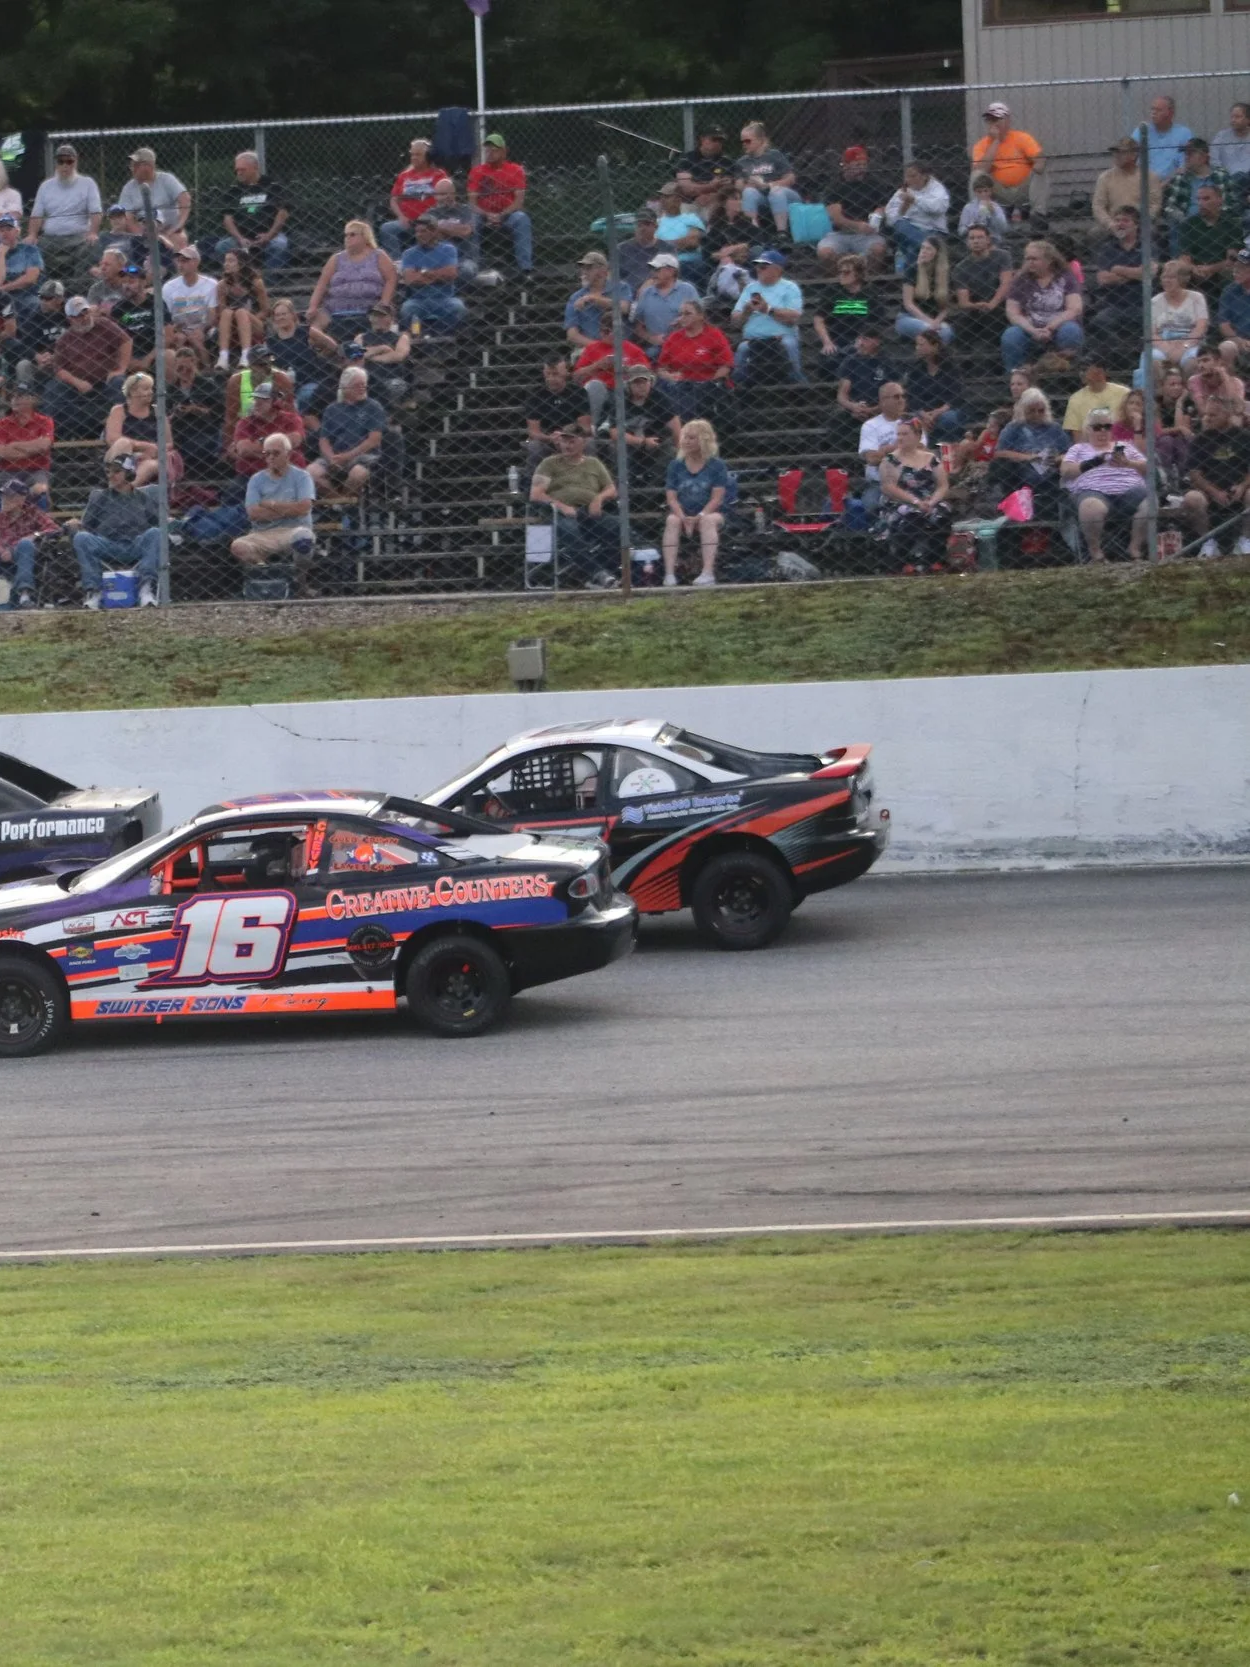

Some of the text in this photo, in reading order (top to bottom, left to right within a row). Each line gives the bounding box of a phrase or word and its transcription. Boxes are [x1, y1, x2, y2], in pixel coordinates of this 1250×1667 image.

[1, 816, 105, 841] Performance
[326, 874, 549, 921] CREATIVE COUNTERS
[110, 911, 149, 927] ACT
[160, 891, 296, 983] 16
[94, 995, 247, 1015] SWITSER SONS
